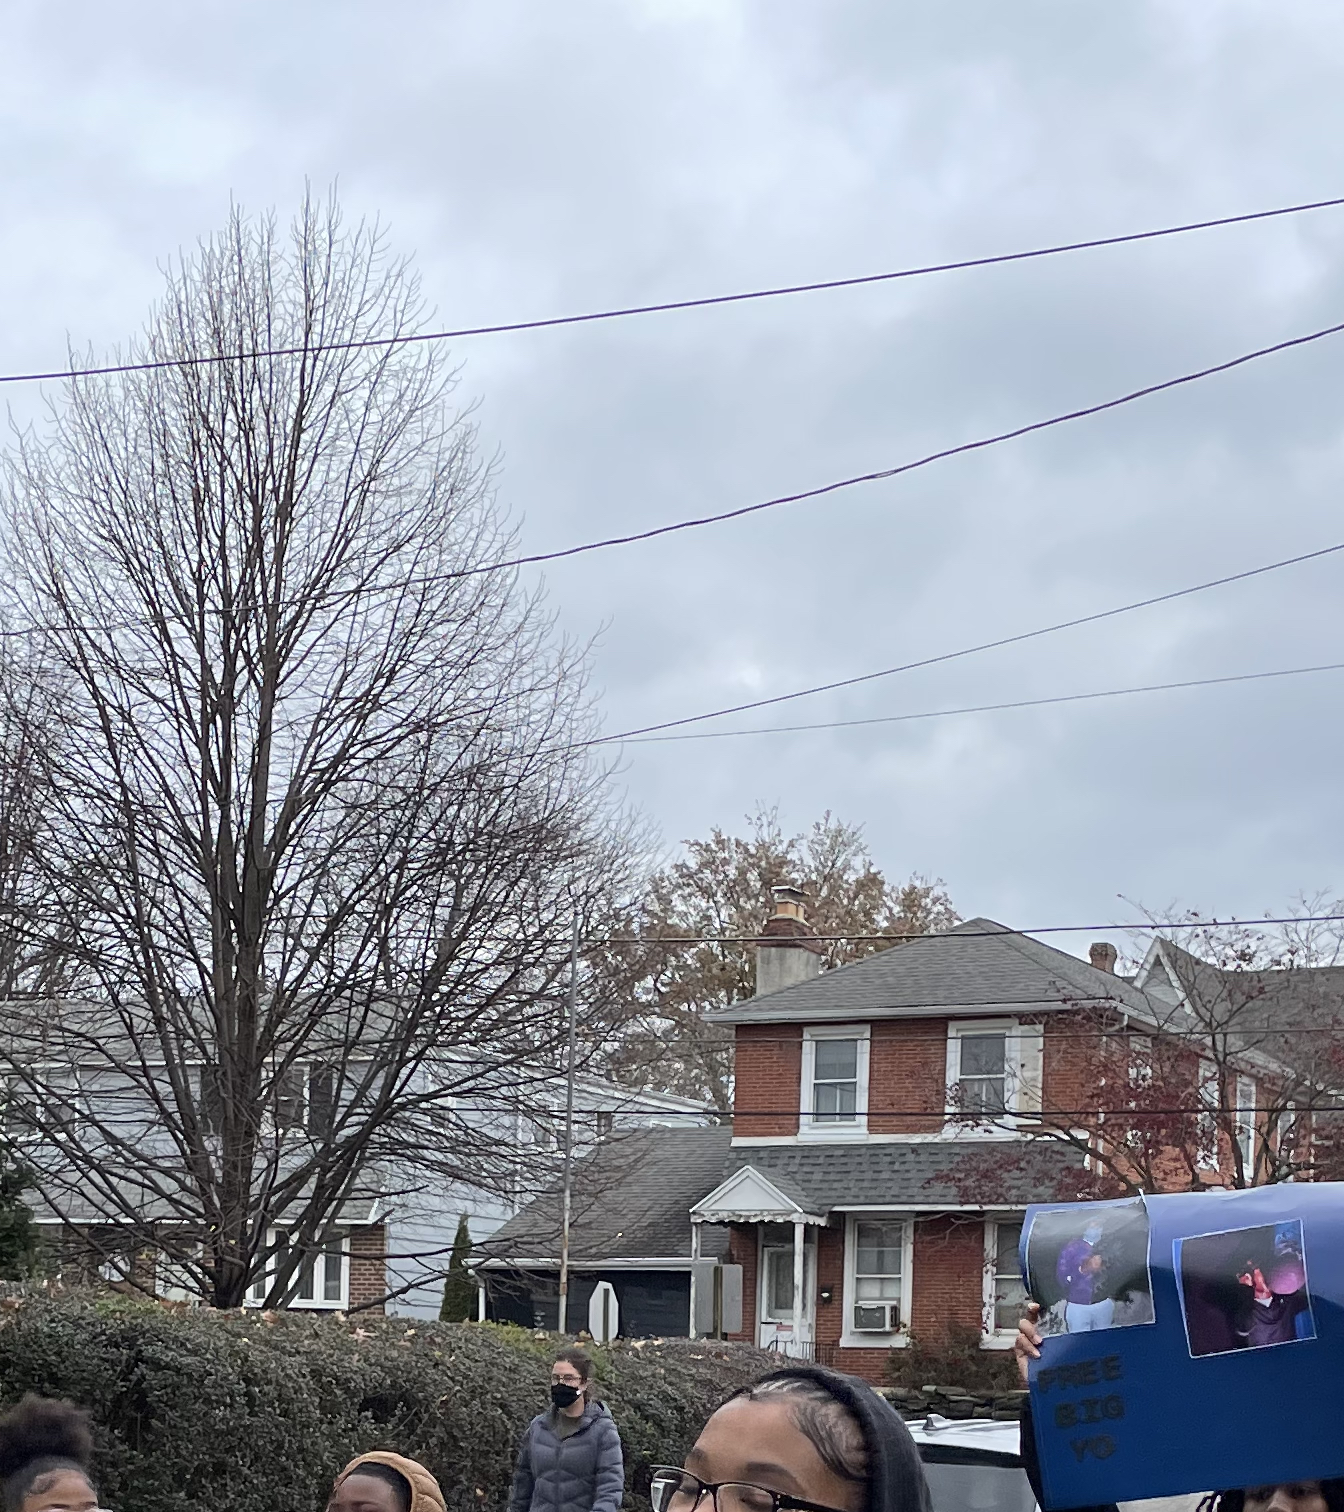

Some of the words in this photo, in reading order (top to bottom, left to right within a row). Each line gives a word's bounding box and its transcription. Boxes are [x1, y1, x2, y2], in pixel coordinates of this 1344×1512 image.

[1037, 1354, 1124, 1392] FREE
[1056, 1394, 1126, 1428] BIG
[1070, 1434, 1116, 1463] YO
